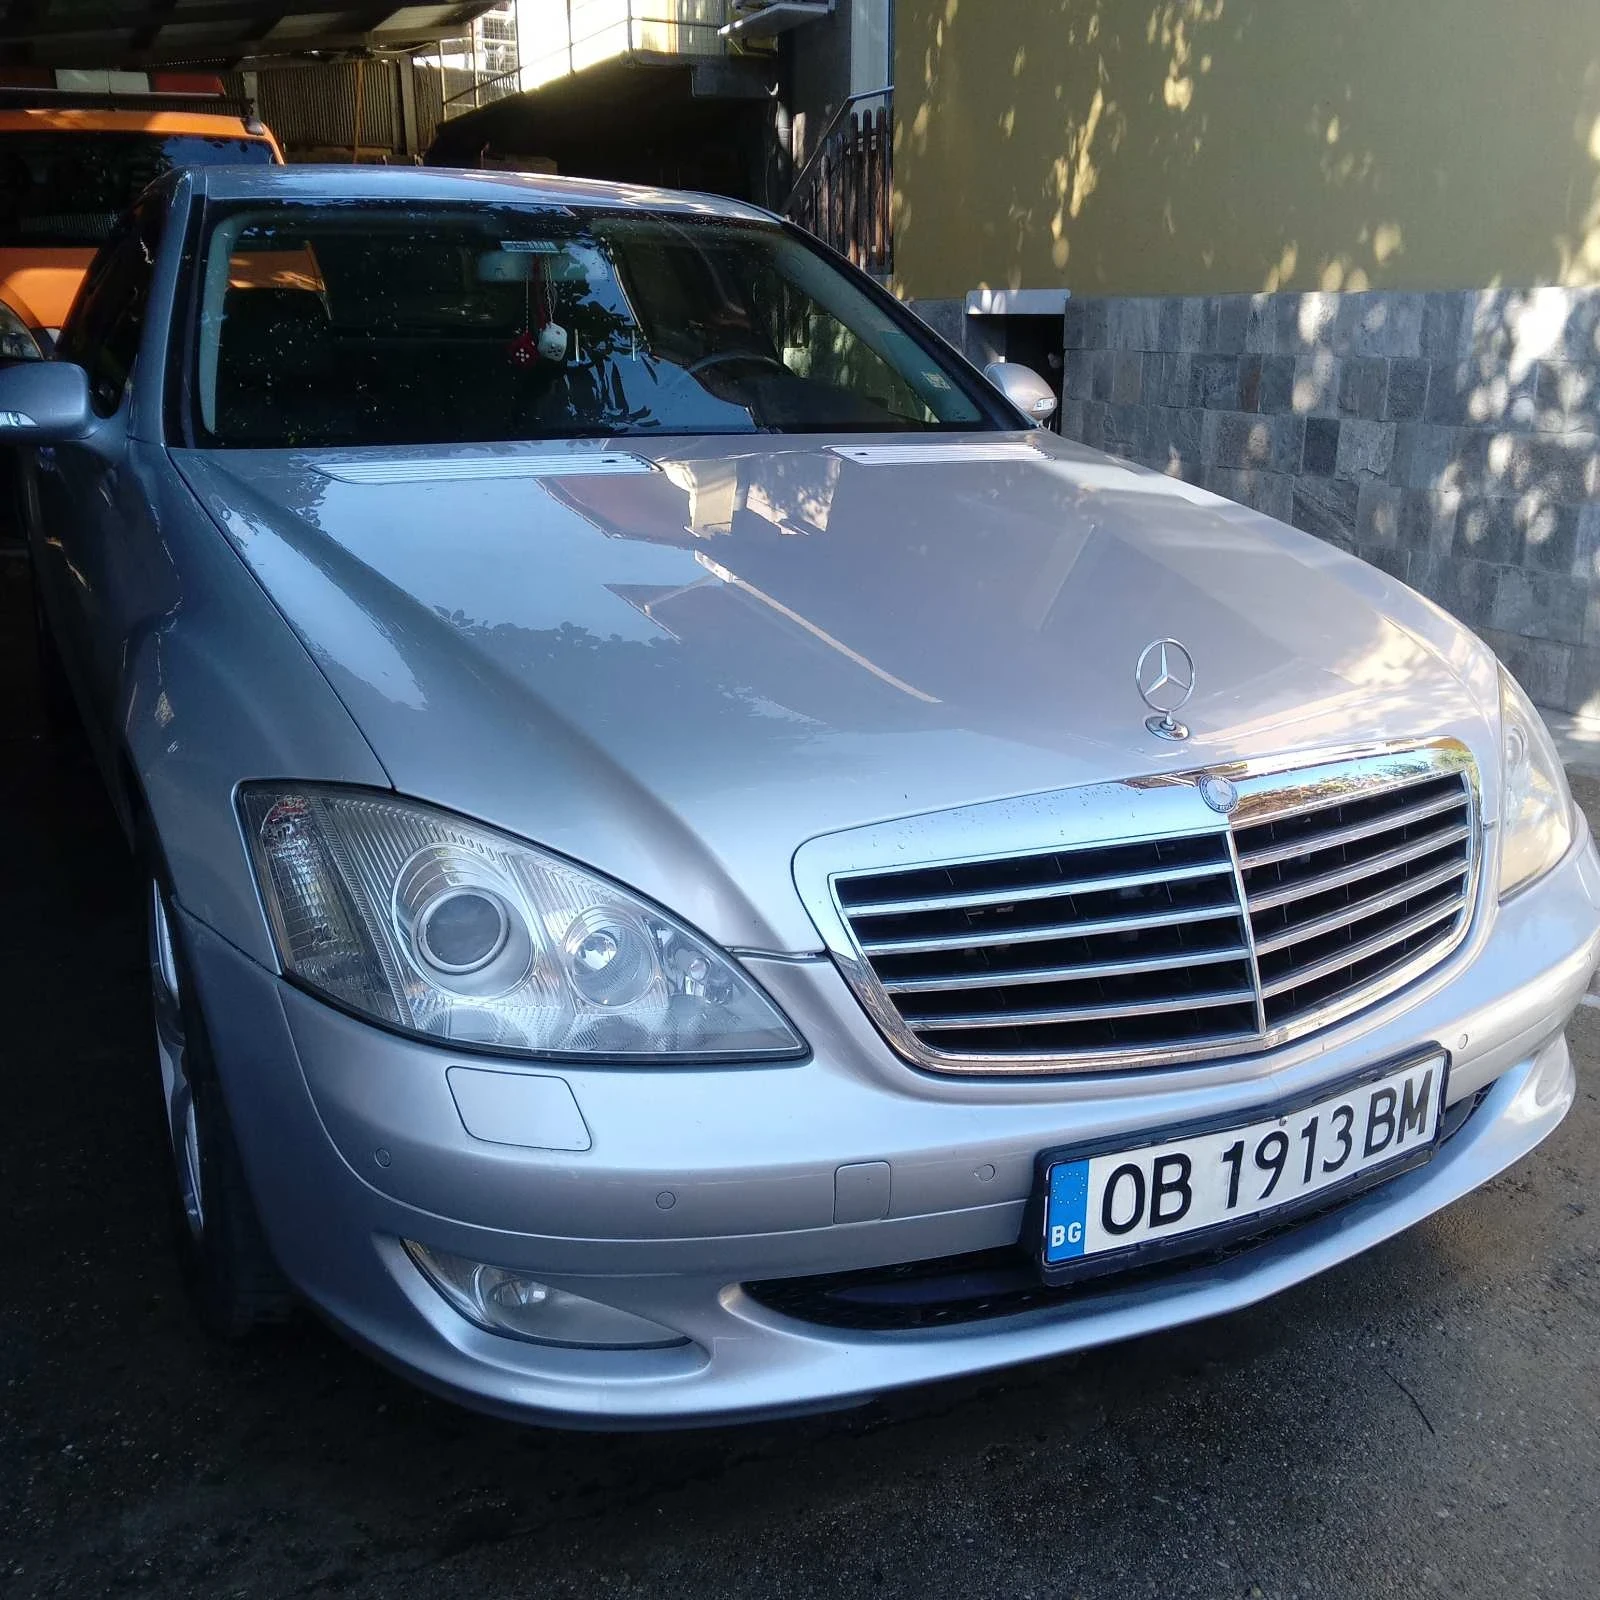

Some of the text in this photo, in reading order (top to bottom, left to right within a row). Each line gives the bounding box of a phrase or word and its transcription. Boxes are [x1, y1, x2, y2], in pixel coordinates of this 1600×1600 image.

[1100, 1069, 1434, 1236] OB 1913 BM
[1051, 1222, 1082, 1248] BG
